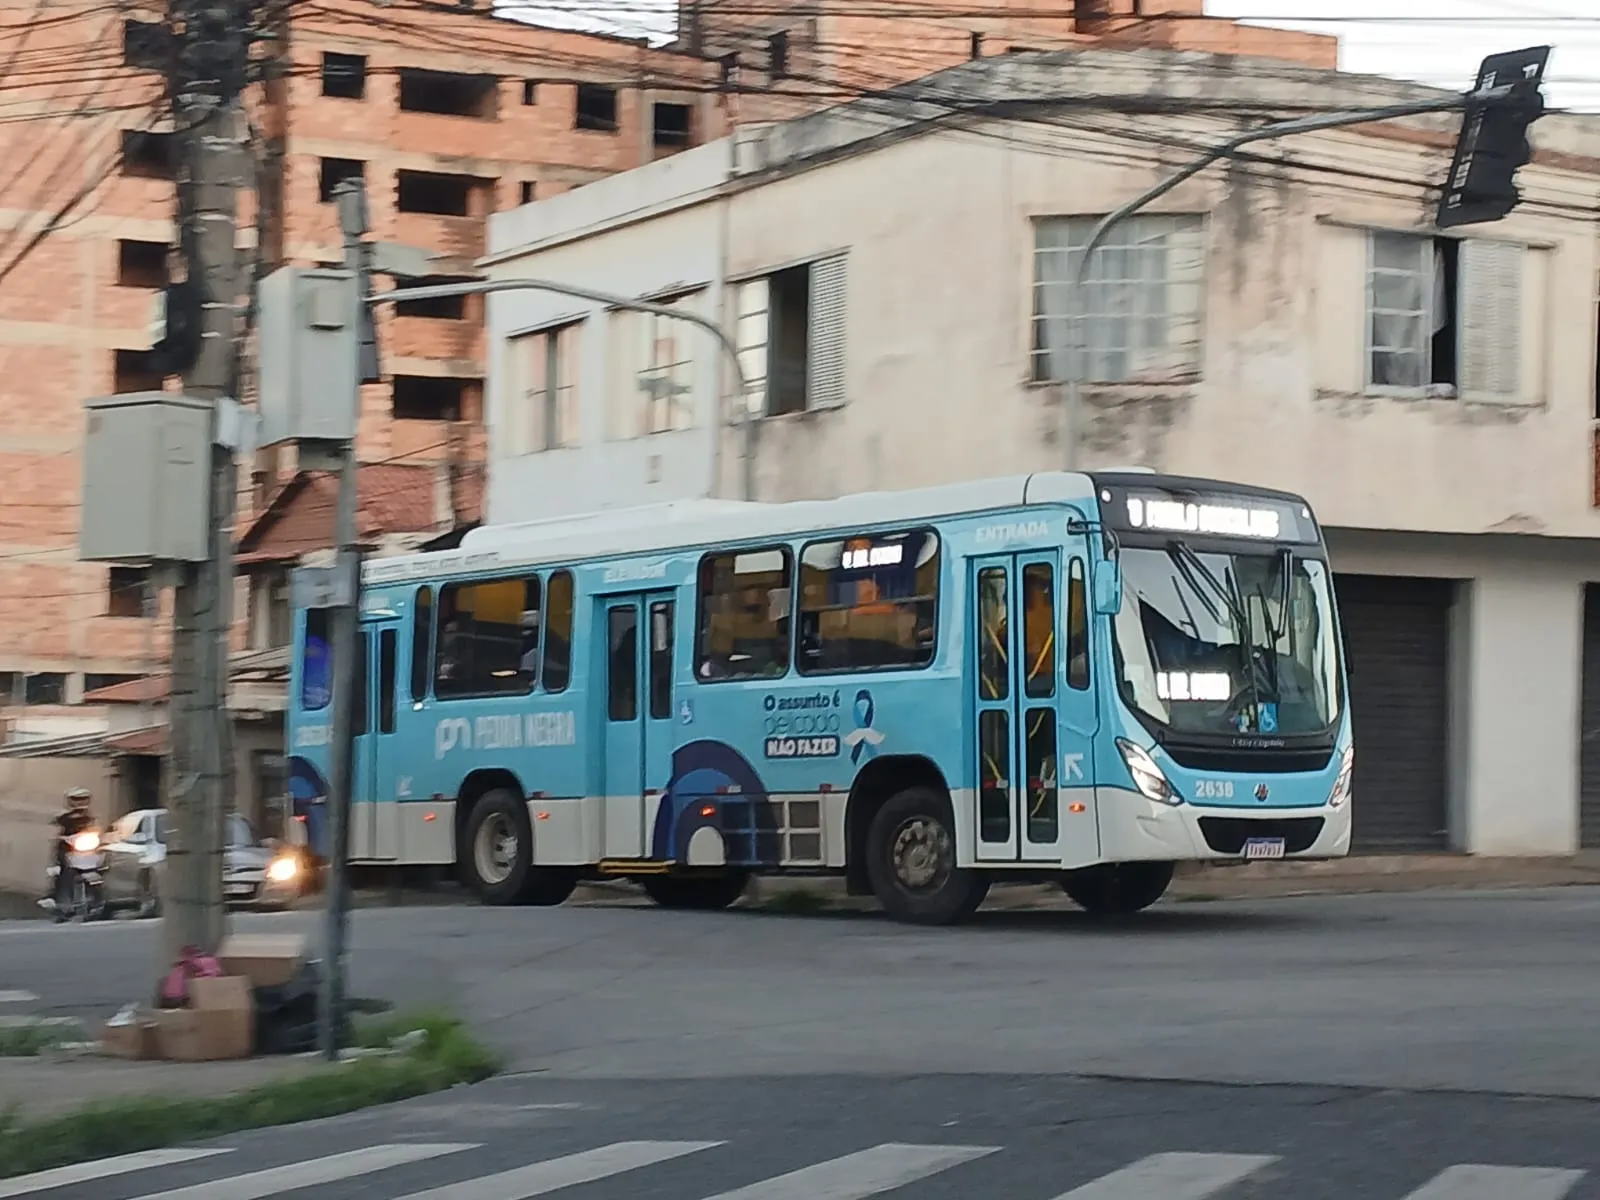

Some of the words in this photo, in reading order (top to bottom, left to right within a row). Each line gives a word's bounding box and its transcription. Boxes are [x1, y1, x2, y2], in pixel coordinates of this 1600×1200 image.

[976, 521, 1049, 542] ENTRADA
[764, 694, 776, 711] O
[778, 692, 831, 711] assunto
[767, 735, 796, 756] NÃO
[797, 737, 837, 755] FAZER
